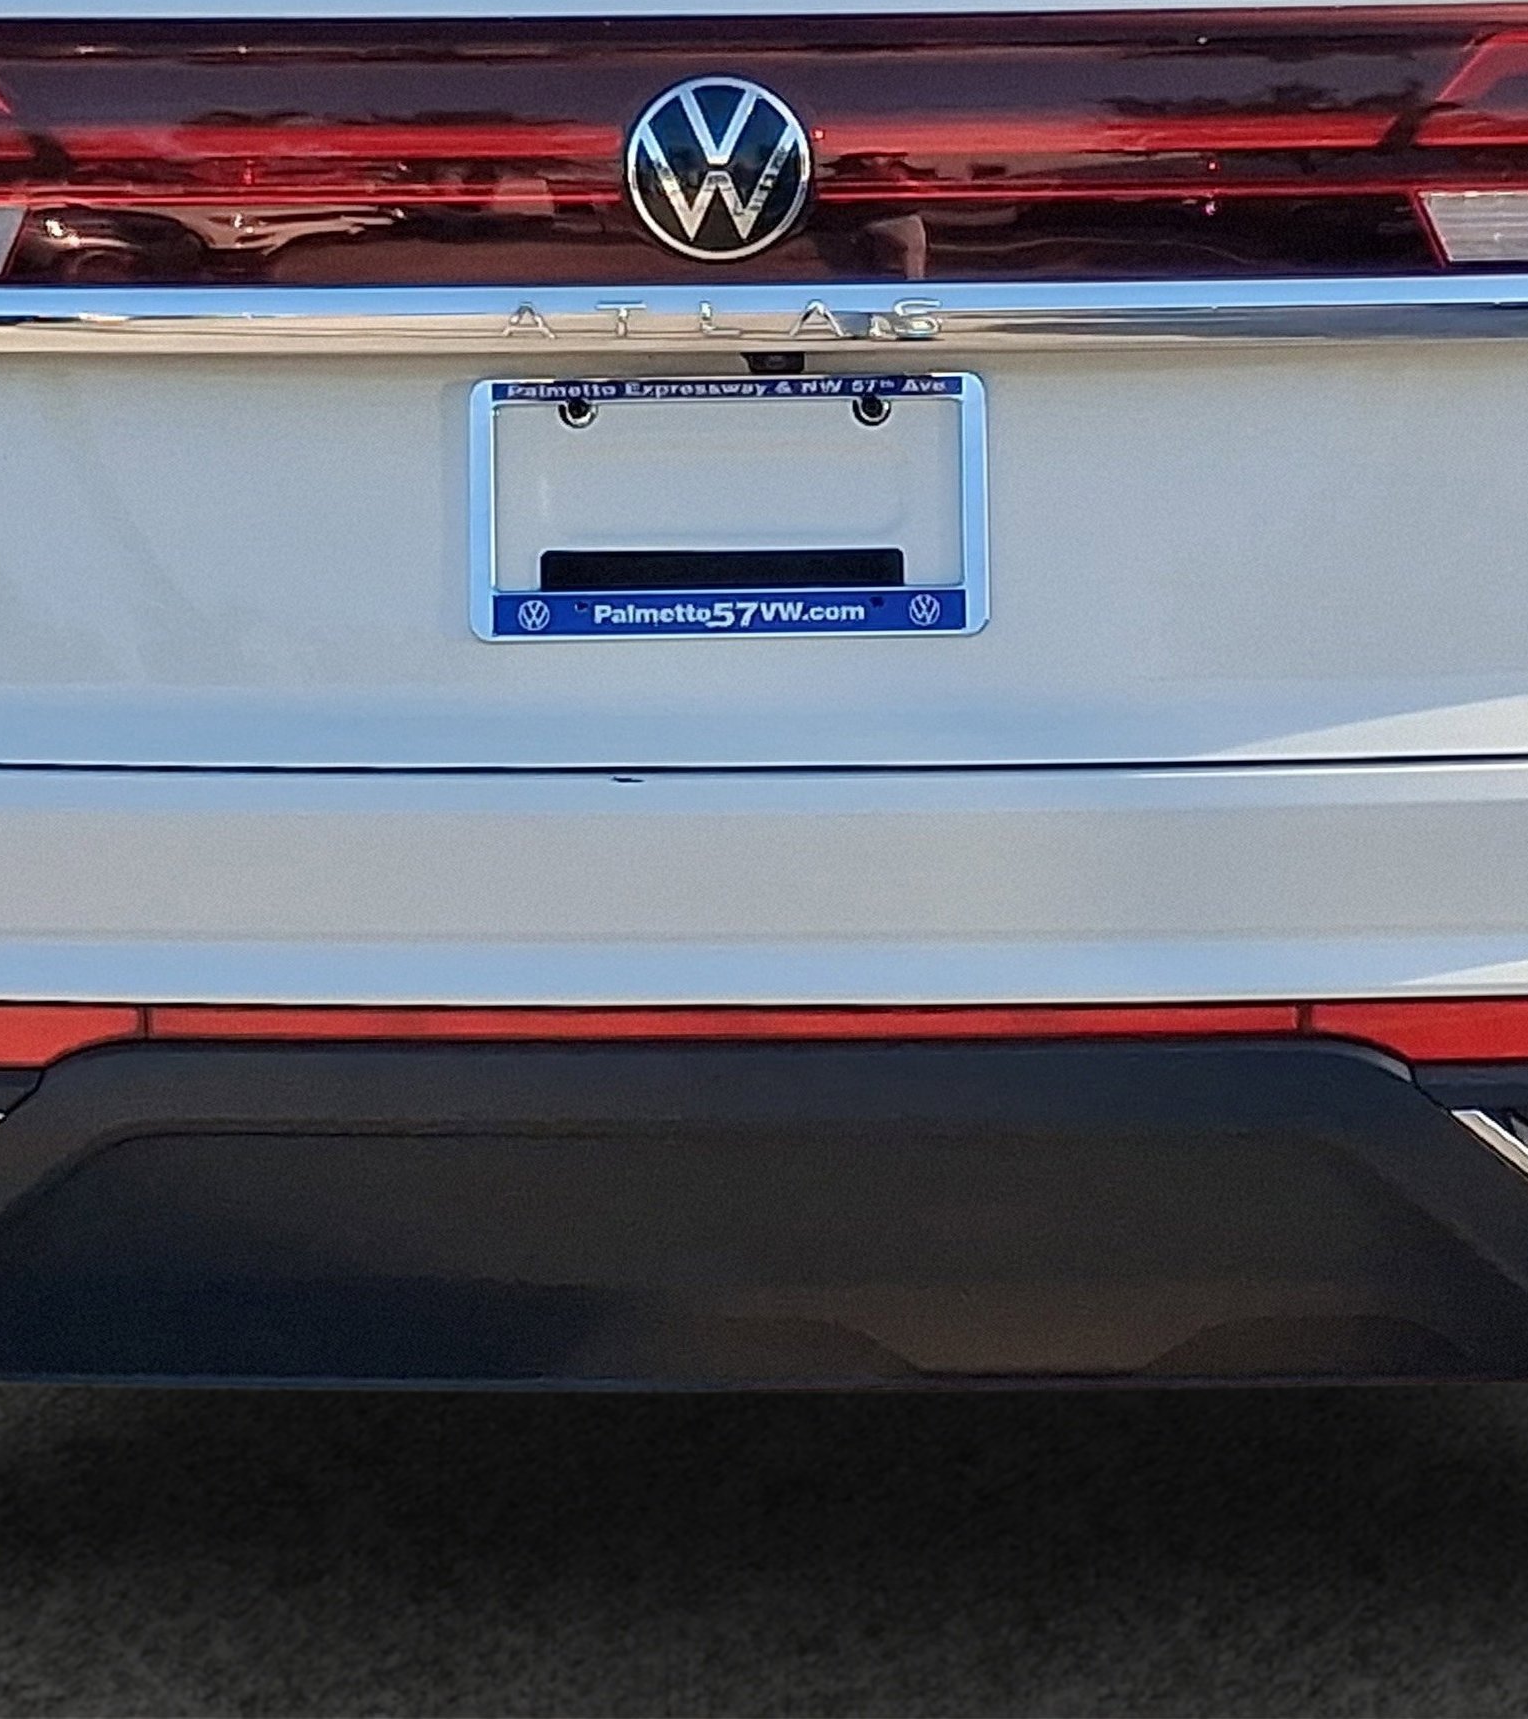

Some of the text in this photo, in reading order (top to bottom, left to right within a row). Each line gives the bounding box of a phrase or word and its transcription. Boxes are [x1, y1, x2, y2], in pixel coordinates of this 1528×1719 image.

[502, 298, 943, 341] ATLAS
[506, 382, 617, 398] Palmetto
[624, 381, 768, 399] Expressway
[801, 379, 843, 393] NW
[901, 378, 947, 393] Ave
[594, 601, 865, 628] Palmetto57VW.com
